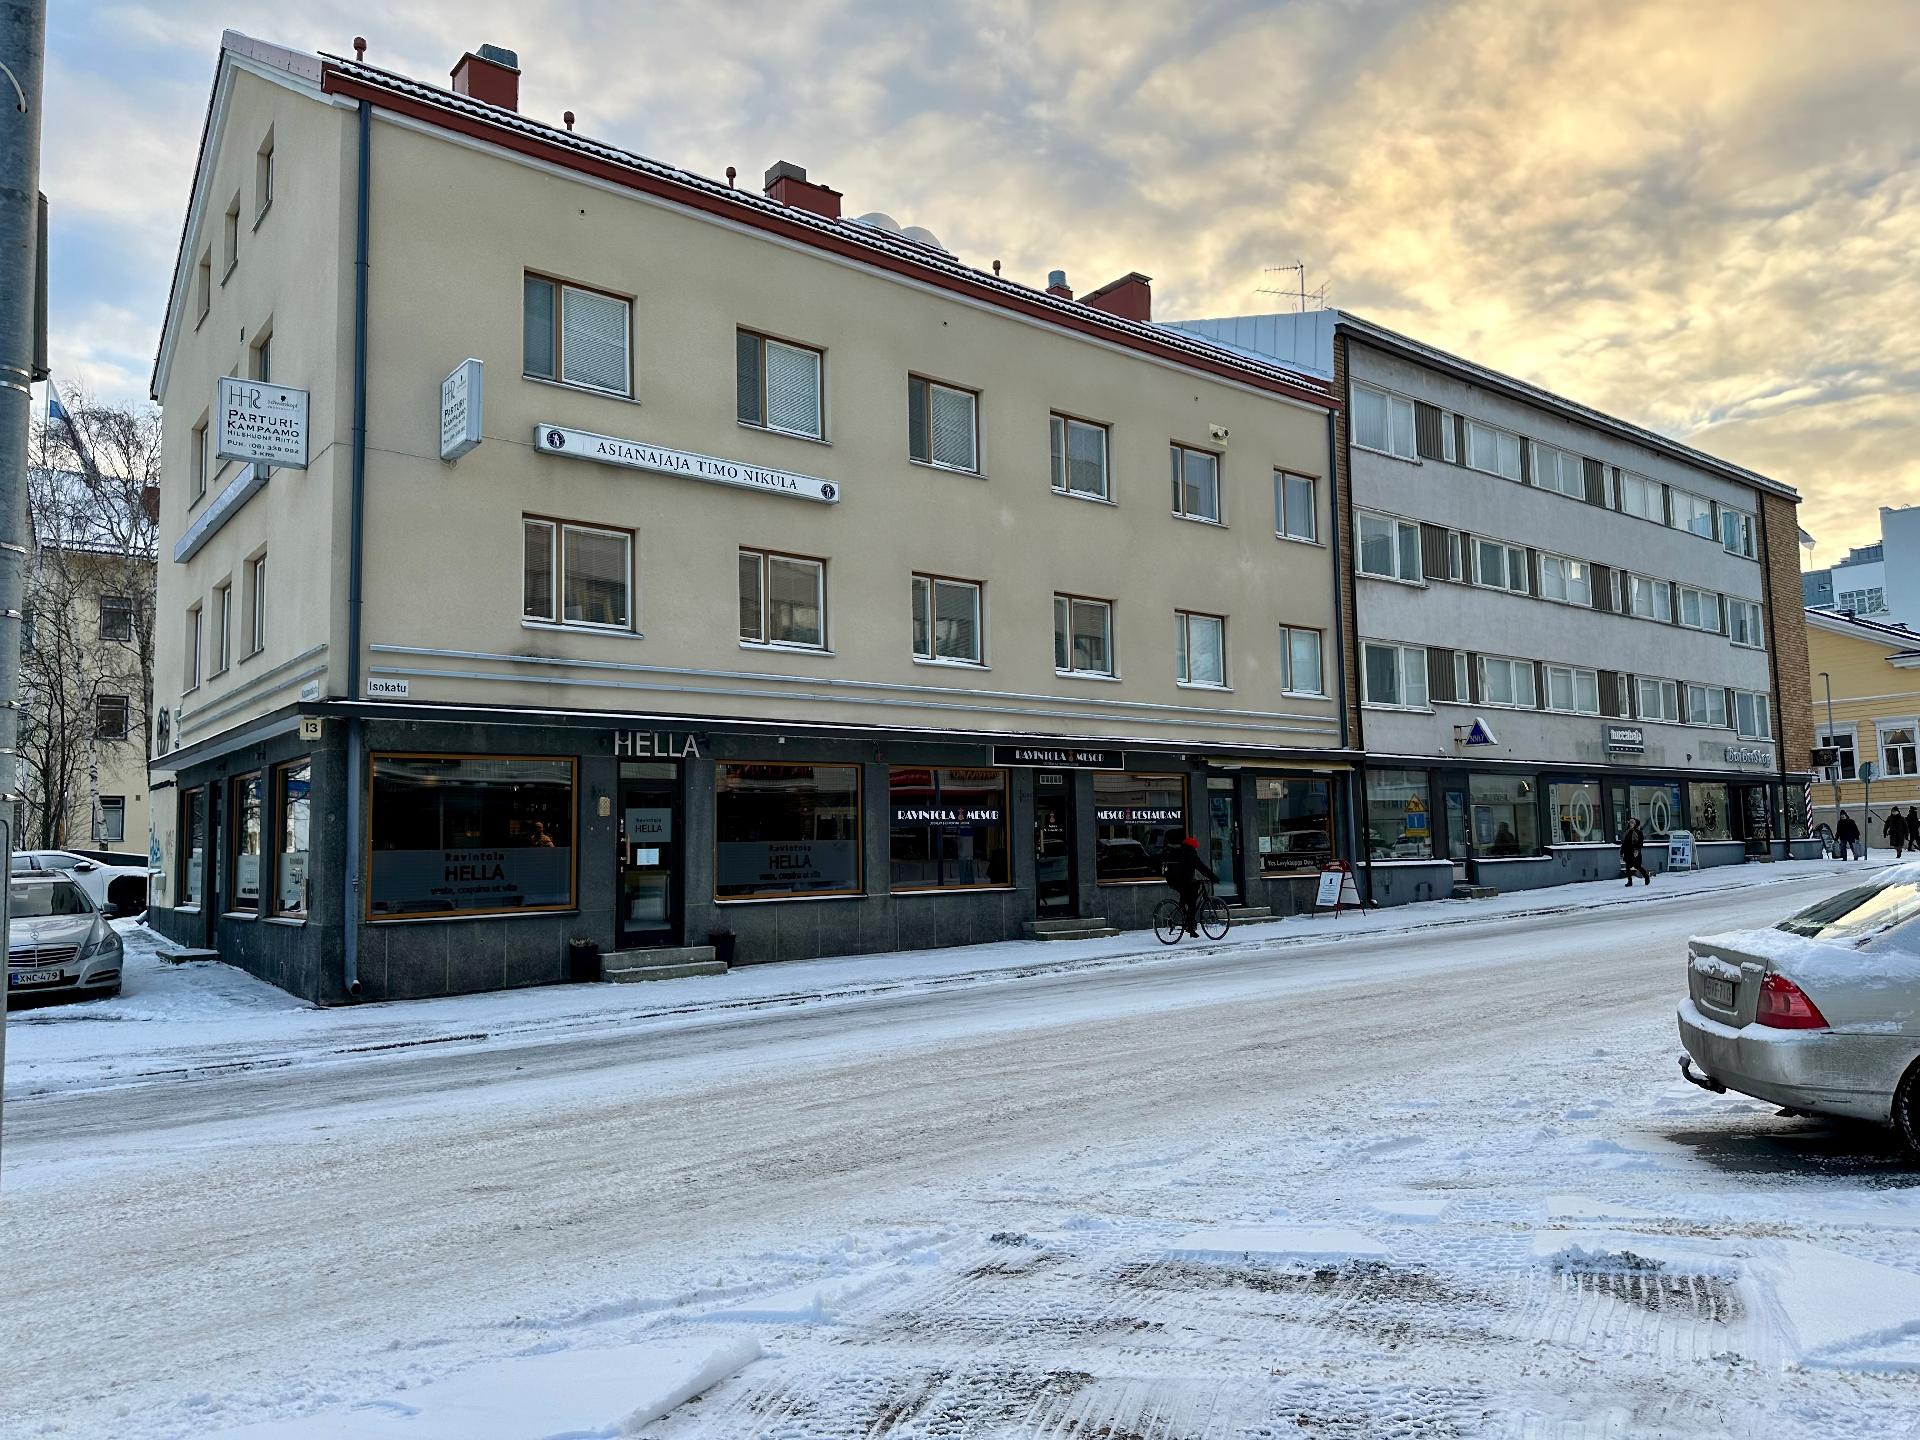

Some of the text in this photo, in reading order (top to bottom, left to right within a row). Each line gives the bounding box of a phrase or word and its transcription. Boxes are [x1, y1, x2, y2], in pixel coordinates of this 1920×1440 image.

[228, 409, 299, 428] PARTURI-
[227, 420, 300, 438] KAMPAAMO
[597, 442, 799, 490] ASIANAJAJA TIMO NIKULA
[369, 680, 407, 693] Isokatu
[305, 722, 318, 733] 13
[614, 731, 700, 758] HELLA
[897, 810, 999, 820] RAVINTOLA MESOB
[1096, 810, 1182, 820] MESOB RESTAURANT
[635, 825, 663, 833] HELLA
[444, 852, 505, 862] Ravintola
[769, 854, 813, 870] HELLA
[444, 864, 505, 881] HELLA
[20, 972, 58, 983] XNC-479
